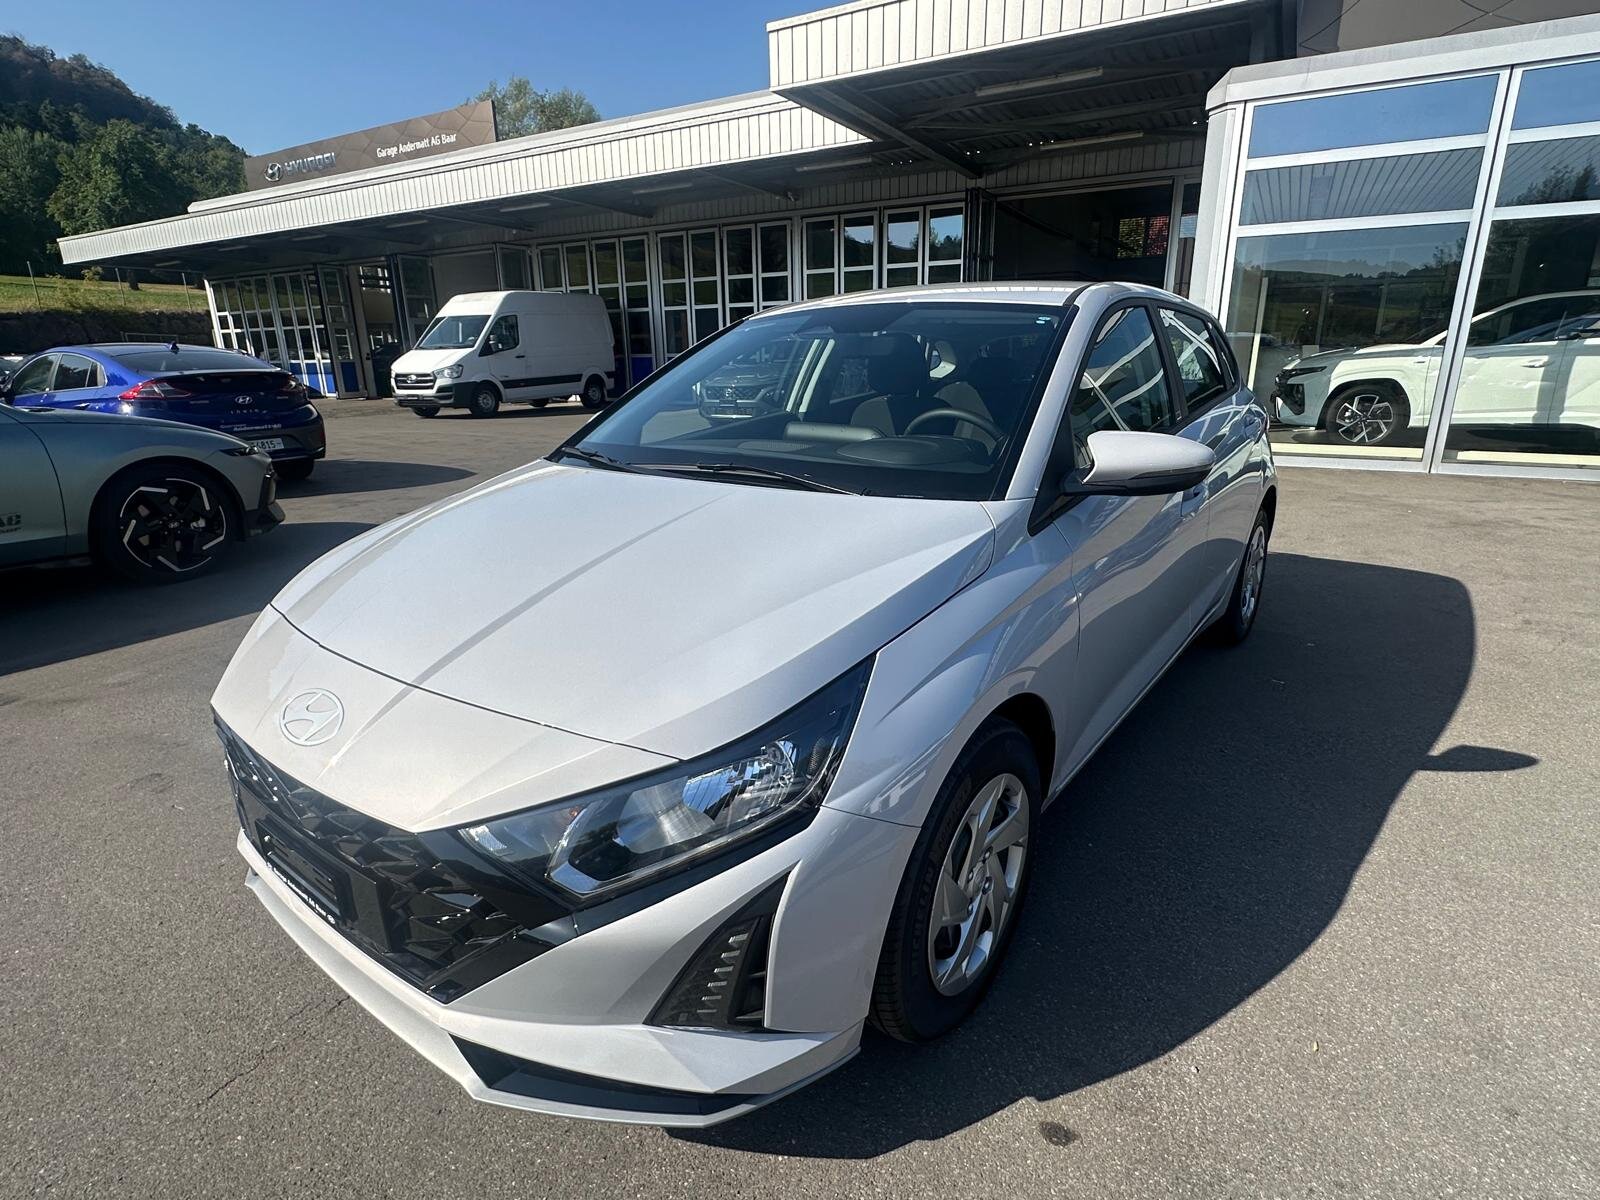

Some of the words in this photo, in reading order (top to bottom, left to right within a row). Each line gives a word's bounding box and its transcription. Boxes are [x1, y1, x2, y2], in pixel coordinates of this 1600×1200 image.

[376, 146, 398, 158] Garage
[398, 138, 430, 154] Andermatt
[431, 135, 441, 146] AG
[441, 133, 457, 145] Baar
[284, 152, 336, 174] HYUNDAI
